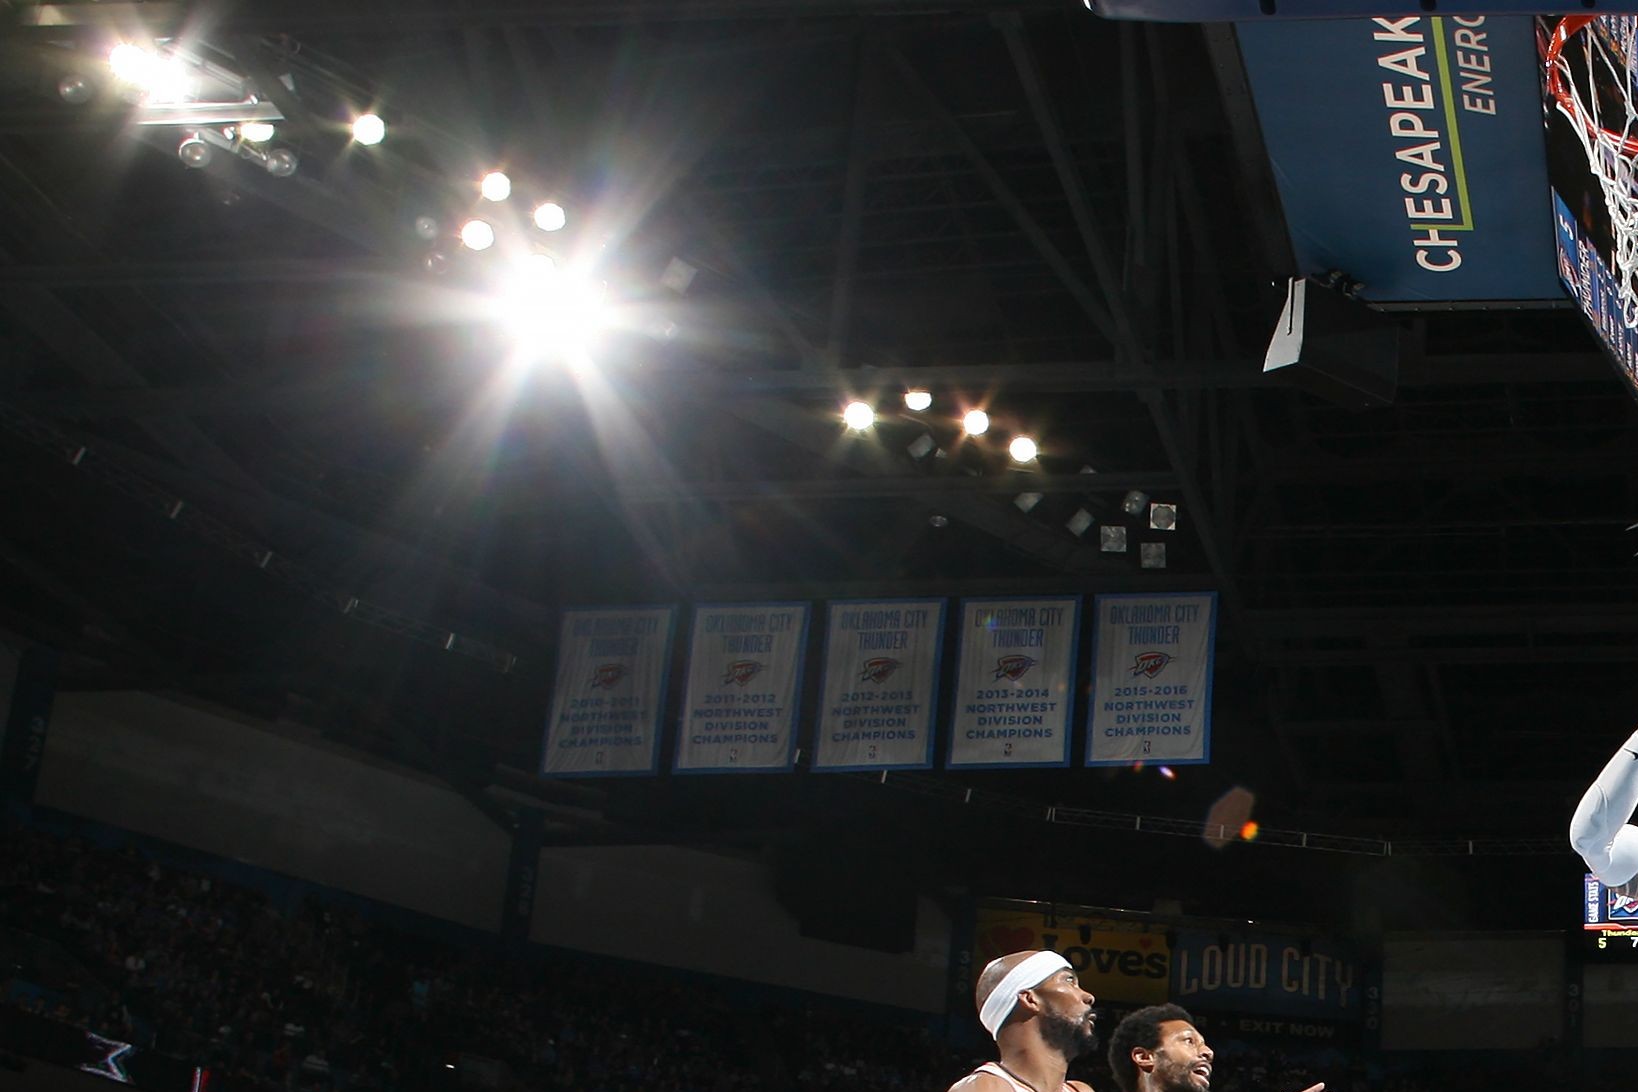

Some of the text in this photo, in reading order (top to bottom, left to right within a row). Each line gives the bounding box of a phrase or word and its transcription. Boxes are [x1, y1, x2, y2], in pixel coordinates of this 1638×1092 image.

[904, 610, 929, 628] CITY
[1039, 608, 1063, 626] CITY
[1110, 604, 1199, 624] OKLAHOMA CITY
[858, 631, 909, 650] THUNDER
[991, 629, 1043, 648] THUNDER
[1128, 626, 1180, 645] THUNDER
[976, 689, 1049, 700] 2013-2014
[1114, 685, 1187, 697] 2015-2016
[831, 704, 921, 717] NORTHWEST
[965, 703, 1056, 714] NORTHWEST
[1104, 700, 1194, 712] NORTHWEST
[693, 707, 783, 719] NORTHWEST
[1116, 713, 1181, 724] DIVISION
[704, 721, 769, 732] DIVISION
[843, 718, 907, 729] DIVISION
[977, 716, 1042, 726] DIVISION
[832, 730, 916, 742] CHAMPIONS
[966, 729, 1053, 740] CHAMPIONS
[1105, 726, 1191, 737] CHAMPIONS
[692, 733, 778, 745] CHAMPIONS
[1598, 938, 1607, 949] 5
[1179, 944, 1358, 1008] LOUD CITY
[1239, 1019, 1335, 1038] EXIT NOW
